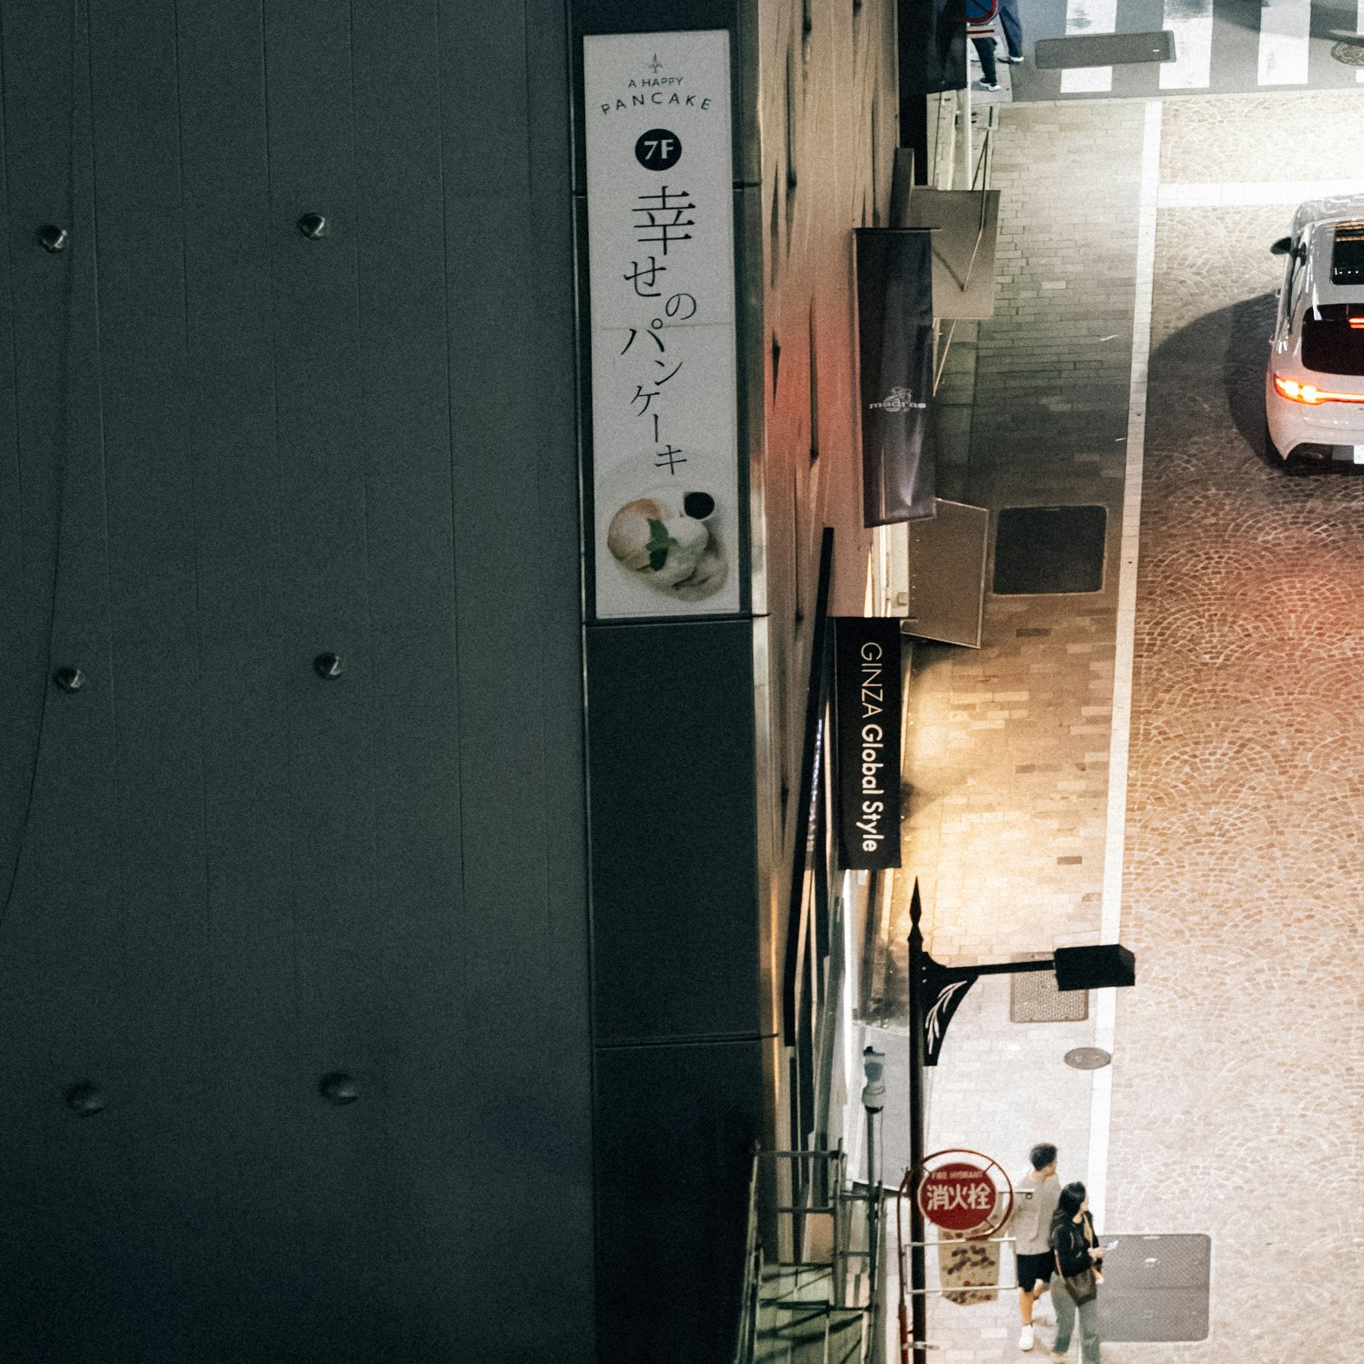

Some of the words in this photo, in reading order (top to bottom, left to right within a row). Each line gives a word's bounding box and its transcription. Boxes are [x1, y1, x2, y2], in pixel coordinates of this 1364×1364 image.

[628, 79, 637, 88] A
[641, 77, 684, 87] HAPPY
[600, 92, 713, 115] PANCAKE
[643, 139, 674, 161] 7F
[620, 185, 698, 476] 幸せのパンケーキ
[869, 397, 927, 409] madras
[860, 642, 884, 719] GINZA
[861, 723, 885, 795] Global
[856, 799, 885, 853] Style
[926, 1182, 991, 1210] 消火栓
